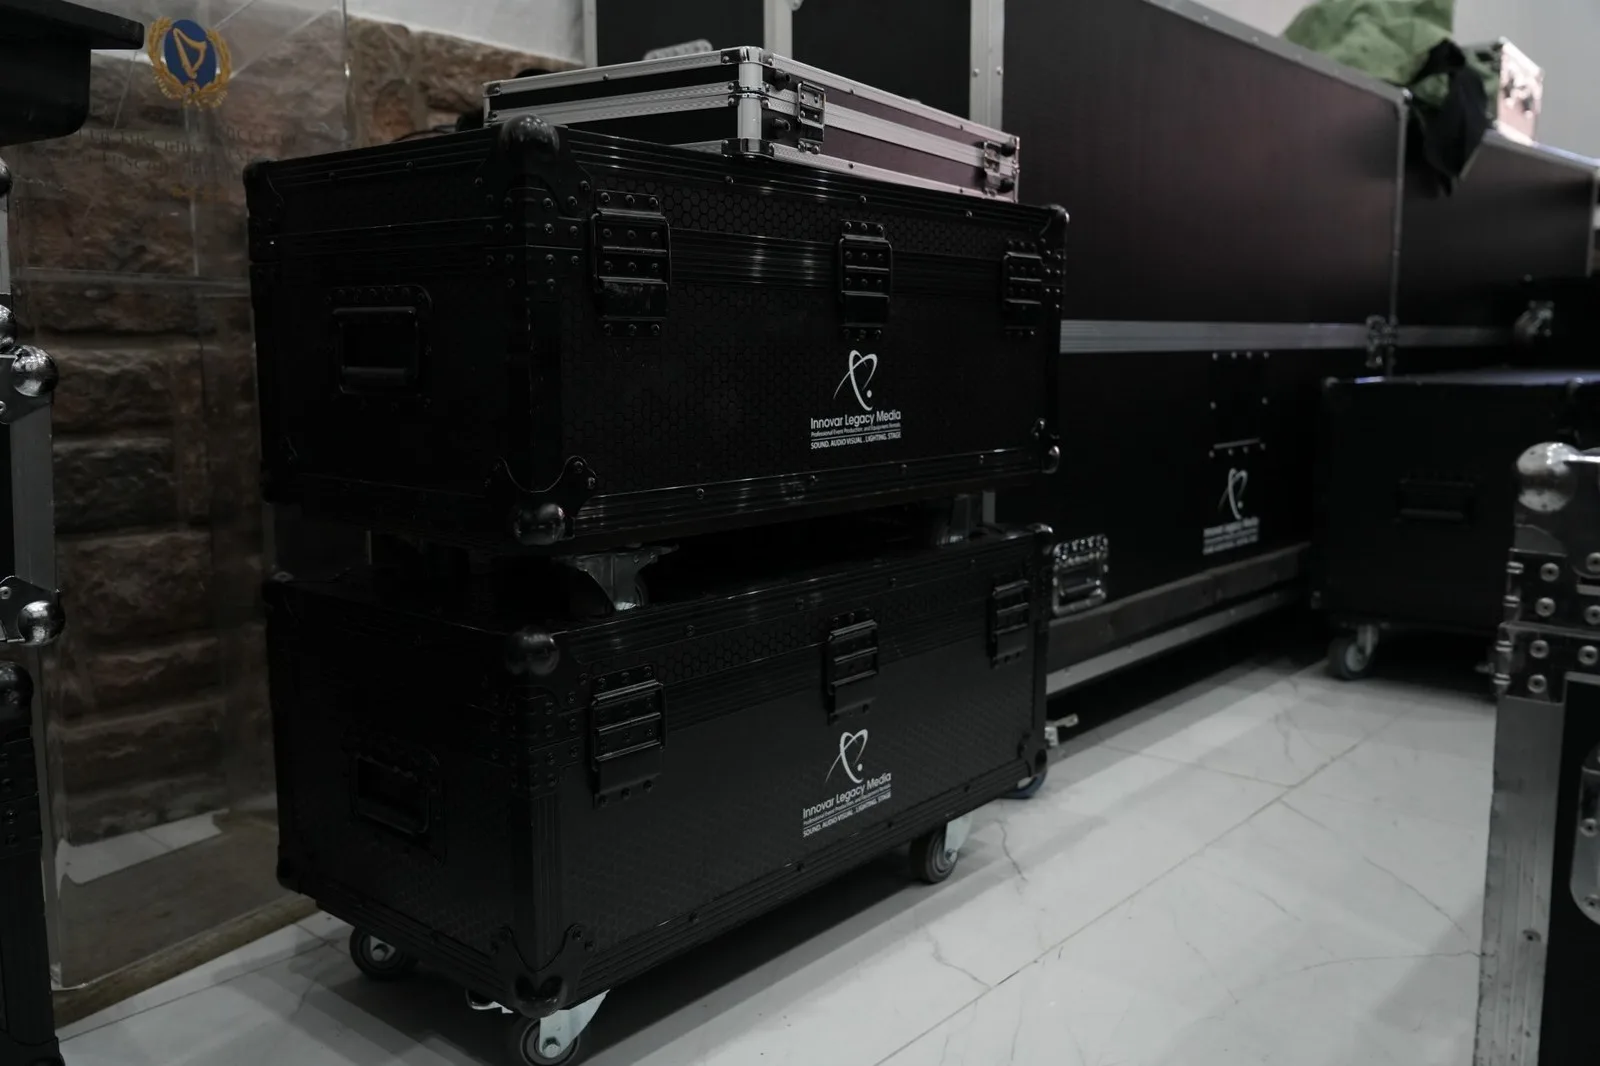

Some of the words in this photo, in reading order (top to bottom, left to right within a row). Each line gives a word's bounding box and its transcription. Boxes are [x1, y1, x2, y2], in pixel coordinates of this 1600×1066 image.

[811, 417, 842, 429] Innovar
[845, 413, 875, 428] Legacy
[876, 410, 901, 422] Media
[831, 438, 846, 447] AUDIO
[803, 798, 834, 819] Innovar
[836, 784, 865, 803] Legacy
[866, 773, 891, 789] Media
